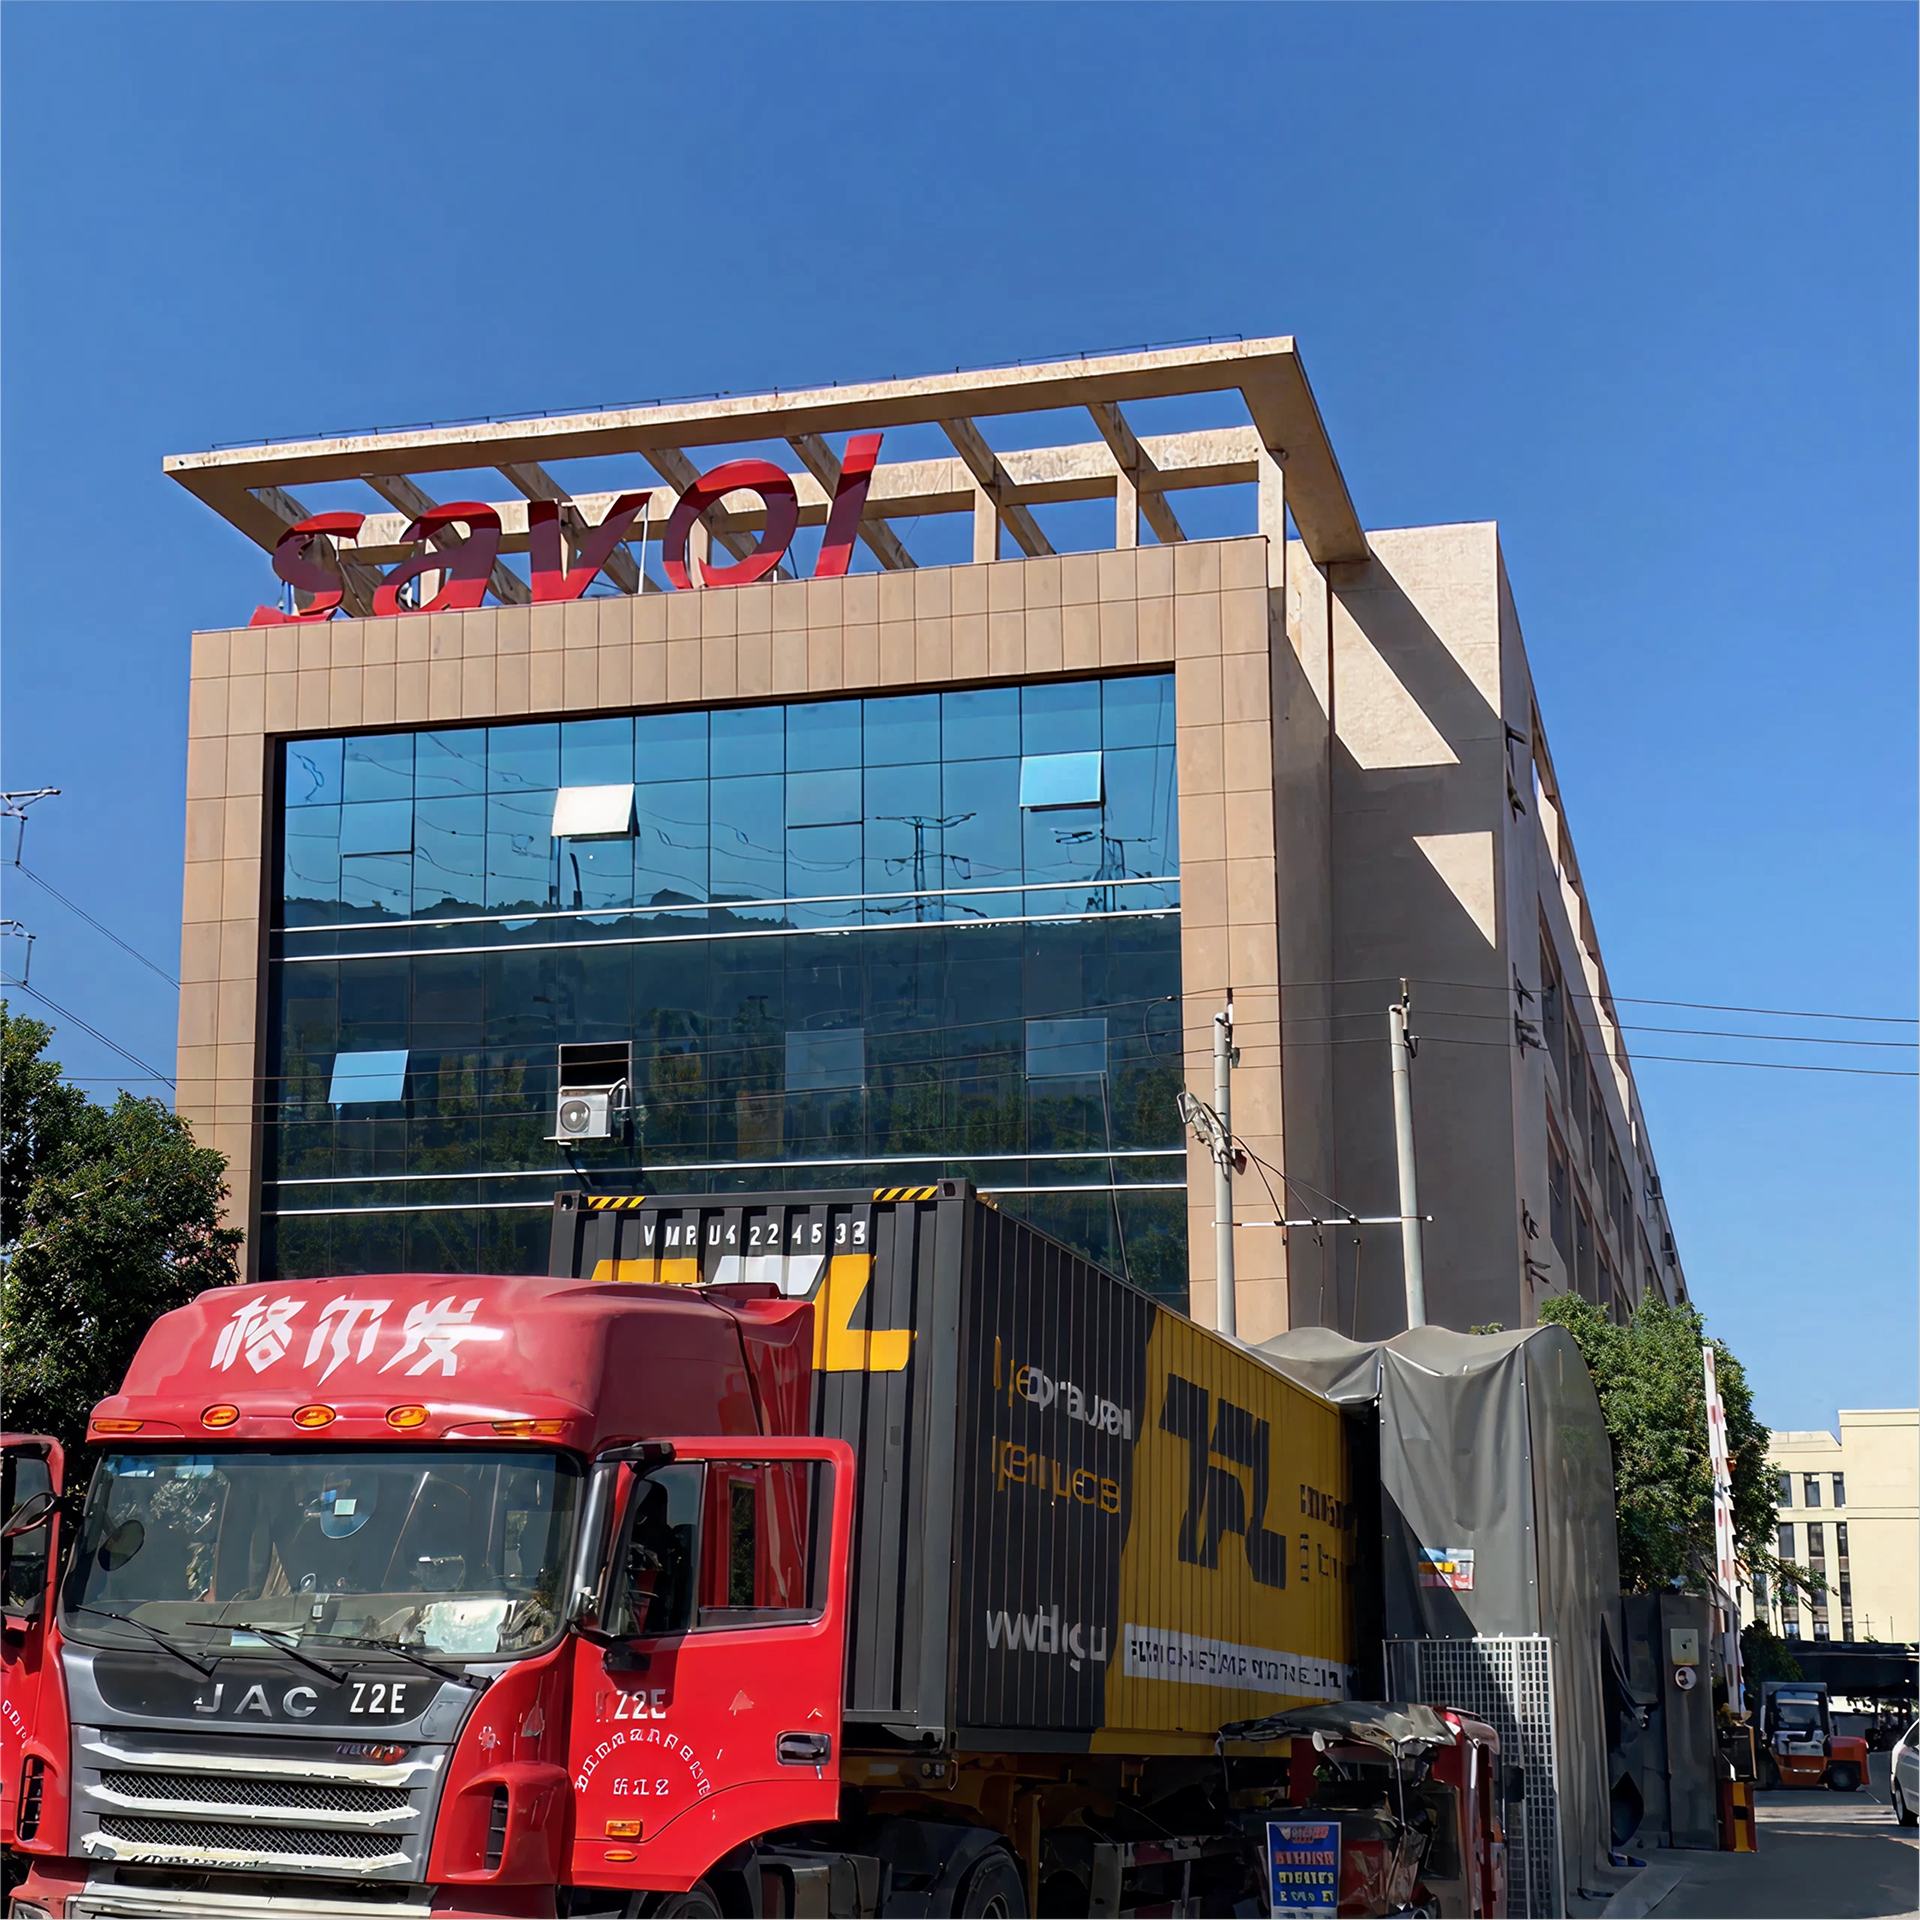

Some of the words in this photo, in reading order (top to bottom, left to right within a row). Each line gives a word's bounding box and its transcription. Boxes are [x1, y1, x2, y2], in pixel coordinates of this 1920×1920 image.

[210, 1294, 504, 1387] 格尔发
[193, 1683, 318, 1718] JAC
[350, 1683, 406, 1714] Z2E
[614, 1688, 666, 1720] Z2E
